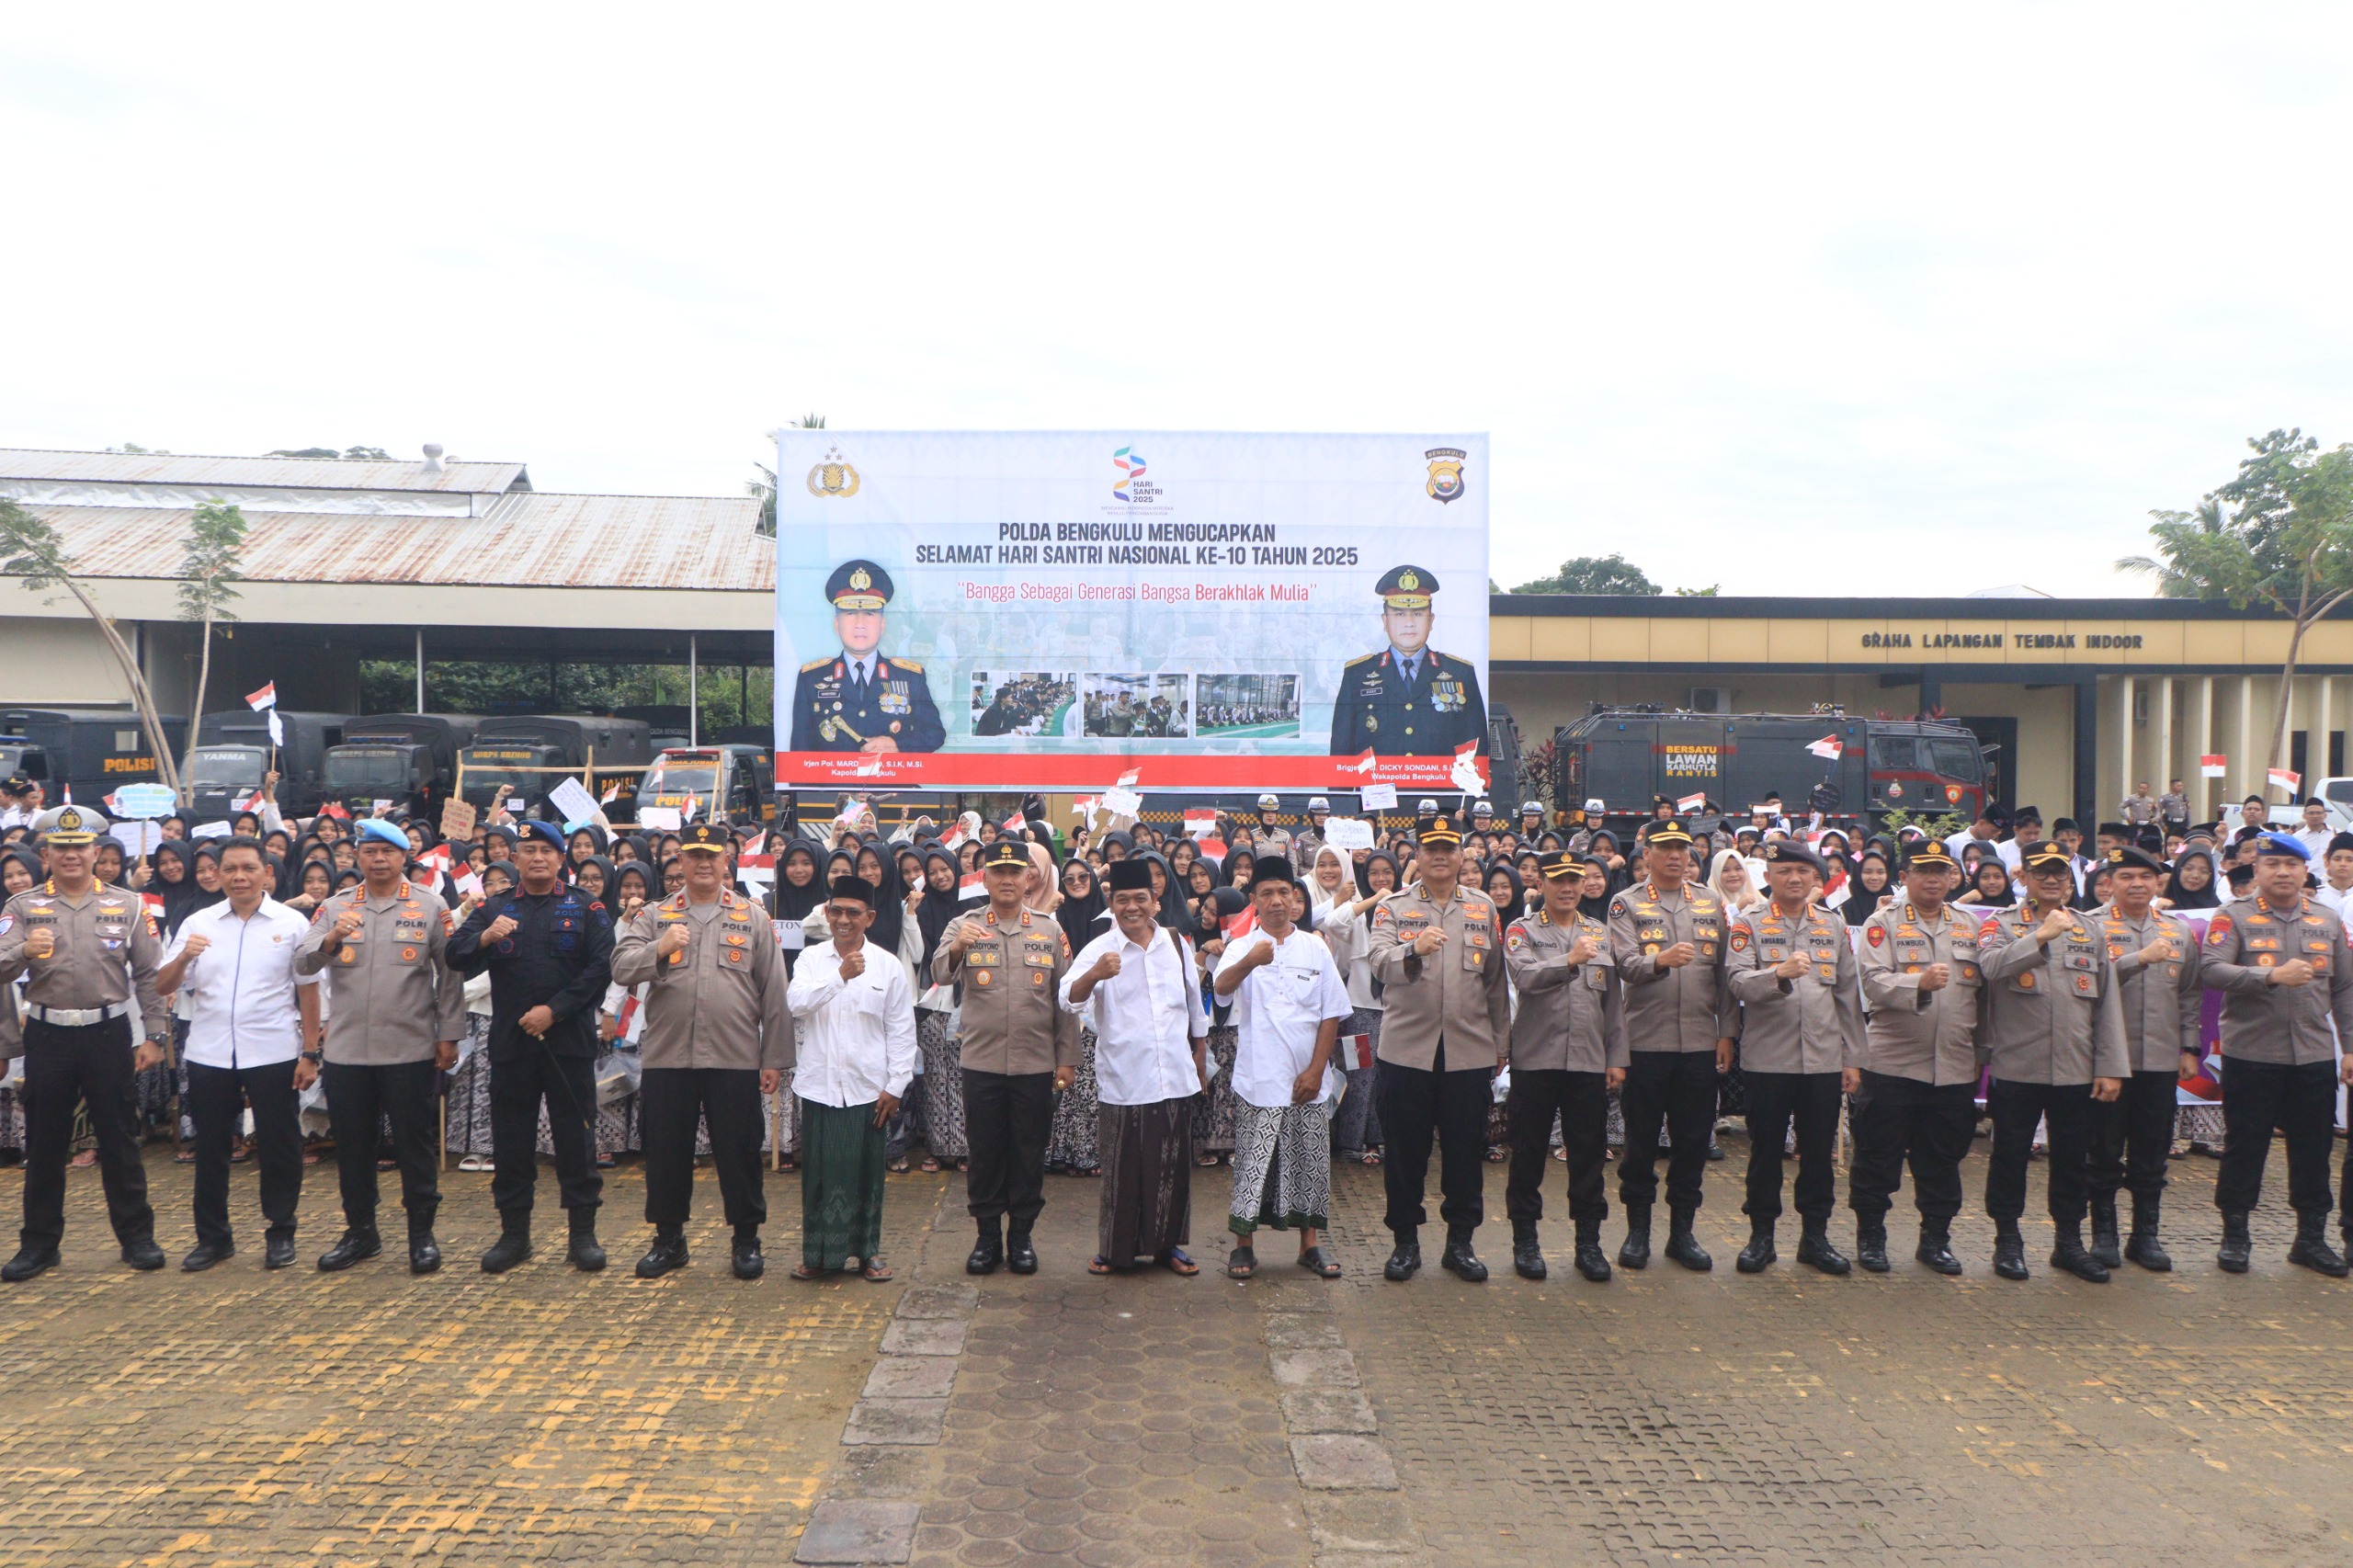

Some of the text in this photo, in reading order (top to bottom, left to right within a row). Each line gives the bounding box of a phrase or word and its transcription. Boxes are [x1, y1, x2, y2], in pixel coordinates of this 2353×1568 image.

[1427, 449, 1465, 458] BENGKULU
[999, 523, 1276, 542] POLDA BENGKULU MENGUCAPKAN
[915, 545, 1358, 566] SELAMAT HARI SANTRI NASIONAL KE-10 TAHUN 2025
[1020, 583, 1073, 603] Sebagai
[1078, 583, 1136, 600] Generasi
[1142, 583, 1190, 604] Bangsa
[1196, 584, 1265, 601] Berakhlak
[1862, 632, 2143, 649] GRAHA LAPANGAN TEMBAK INDOOR
[1666, 745, 1717, 754] BERSATU
[203, 753, 246, 761] YANMA
[500, 751, 531, 759] BRIMOB
[1666, 754, 1717, 765] LAWAN
[104, 757, 155, 772] POLISI
[804, 760, 820, 768] Irjen
[1336, 764, 1358, 773] Brigje
[832, 770, 858, 778] Kapold
[1370, 773, 1446, 781] Wakapolda Bengkulu
[96, 915, 128, 924] POLRI
[395, 920, 426, 928] POLRI
[722, 922, 752, 933] POLRI
[1464, 924, 1488, 932] POLRI
[2302, 928, 2330, 937] POLRI
[1809, 937, 1835, 946] POLRI
[1896, 939, 1926, 948] PAMBUDI
[1024, 943, 1052, 952] POLRI
[2068, 945, 2095, 954] POLRI
